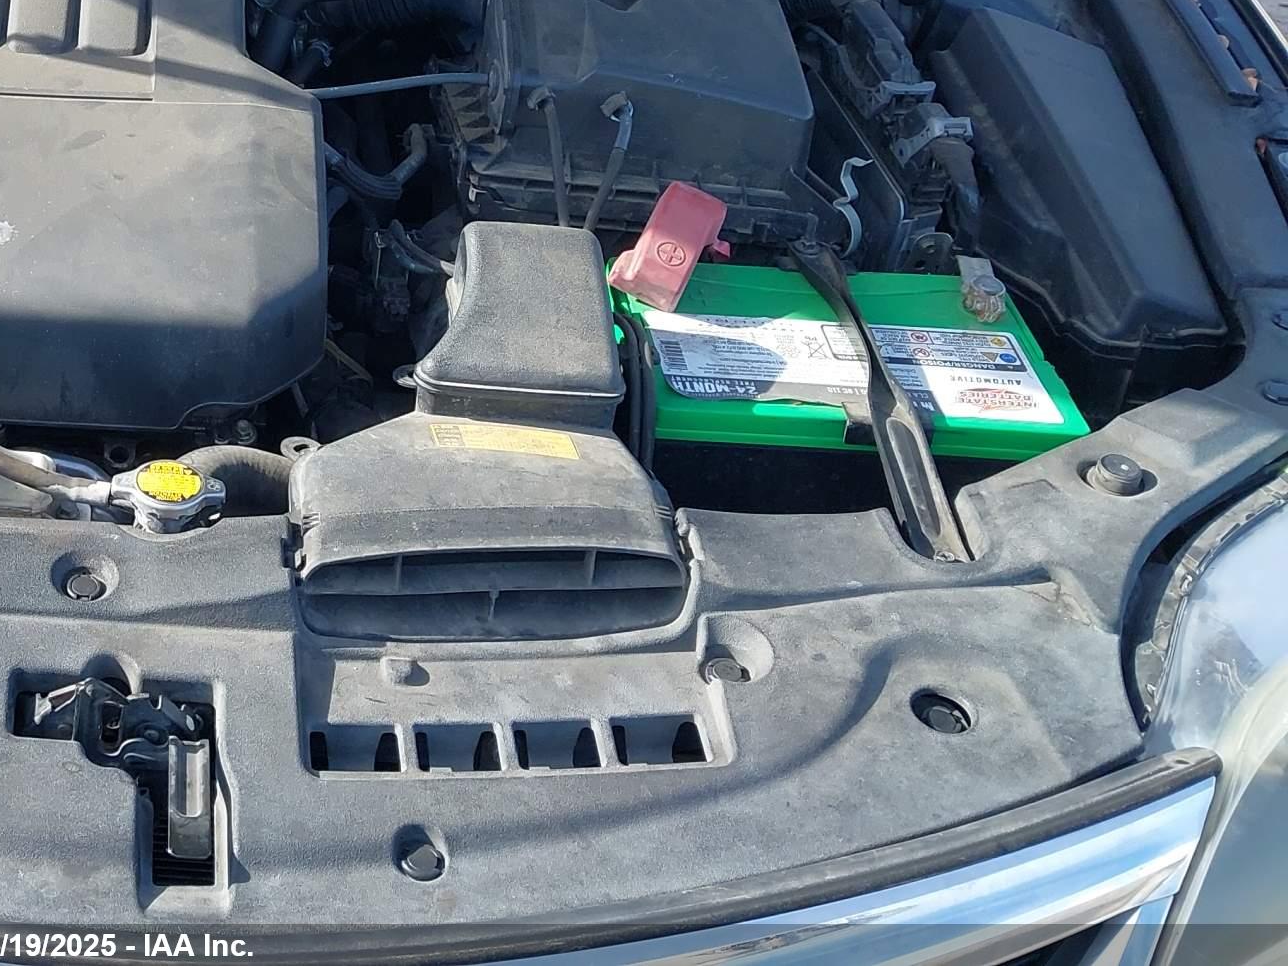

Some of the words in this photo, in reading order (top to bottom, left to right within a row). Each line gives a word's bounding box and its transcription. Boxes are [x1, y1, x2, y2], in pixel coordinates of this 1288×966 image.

[949, 375, 1022, 386] AUTOMOTIVE
[672, 381, 759, 395] 24-MONTH
[959, 391, 1033, 401] BATTERIES
[958, 397, 1038, 409] INTERSTATE
